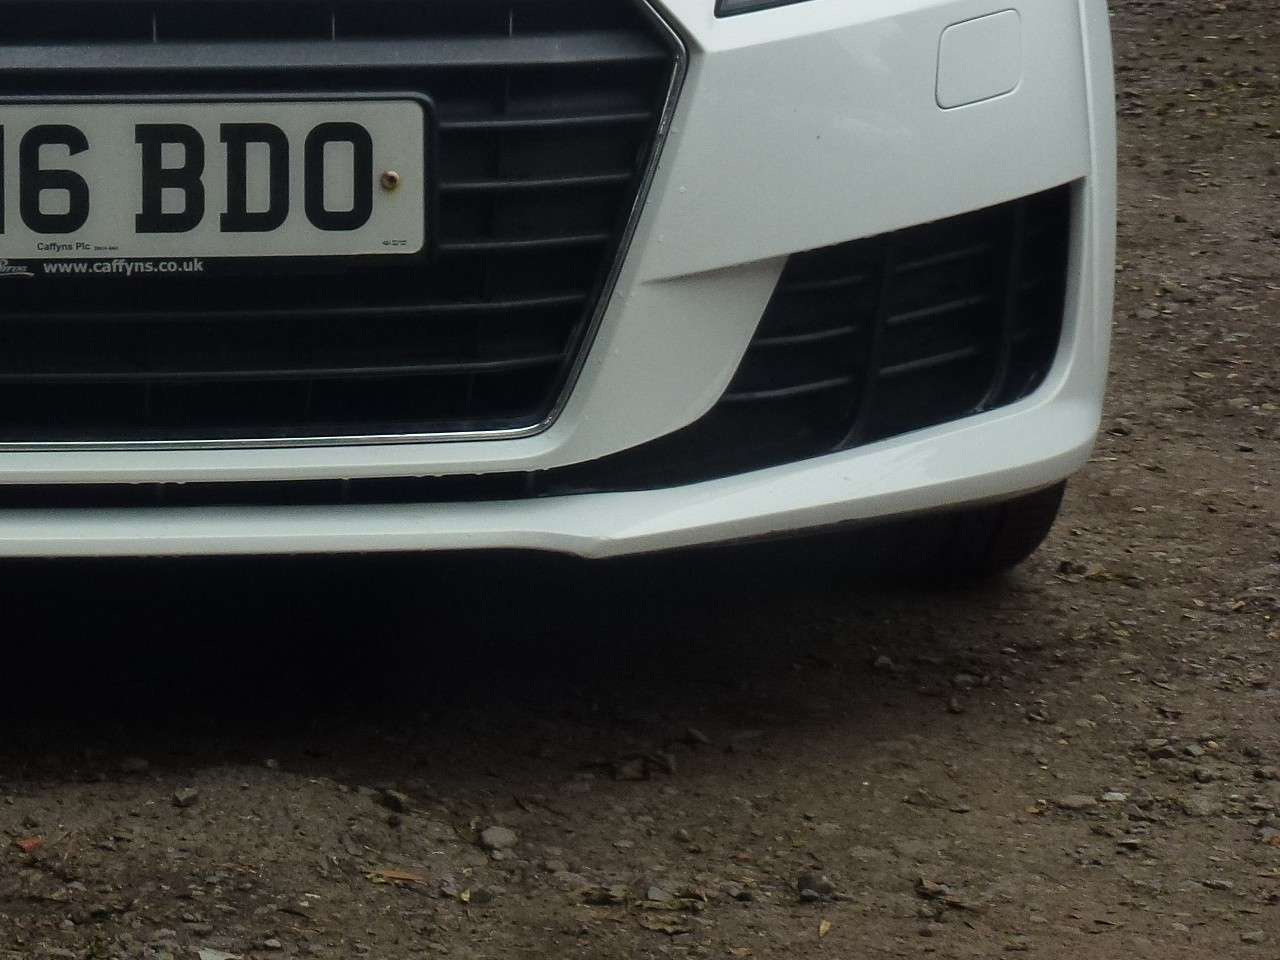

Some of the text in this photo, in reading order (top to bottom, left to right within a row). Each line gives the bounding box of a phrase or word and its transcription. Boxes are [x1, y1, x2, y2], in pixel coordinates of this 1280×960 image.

[135, 122, 374, 233] BDO
[36, 242, 73, 252] Caffyns
[75, 242, 91, 251] Plc
[43, 258, 204, 276] www.caffyns.co.uk
